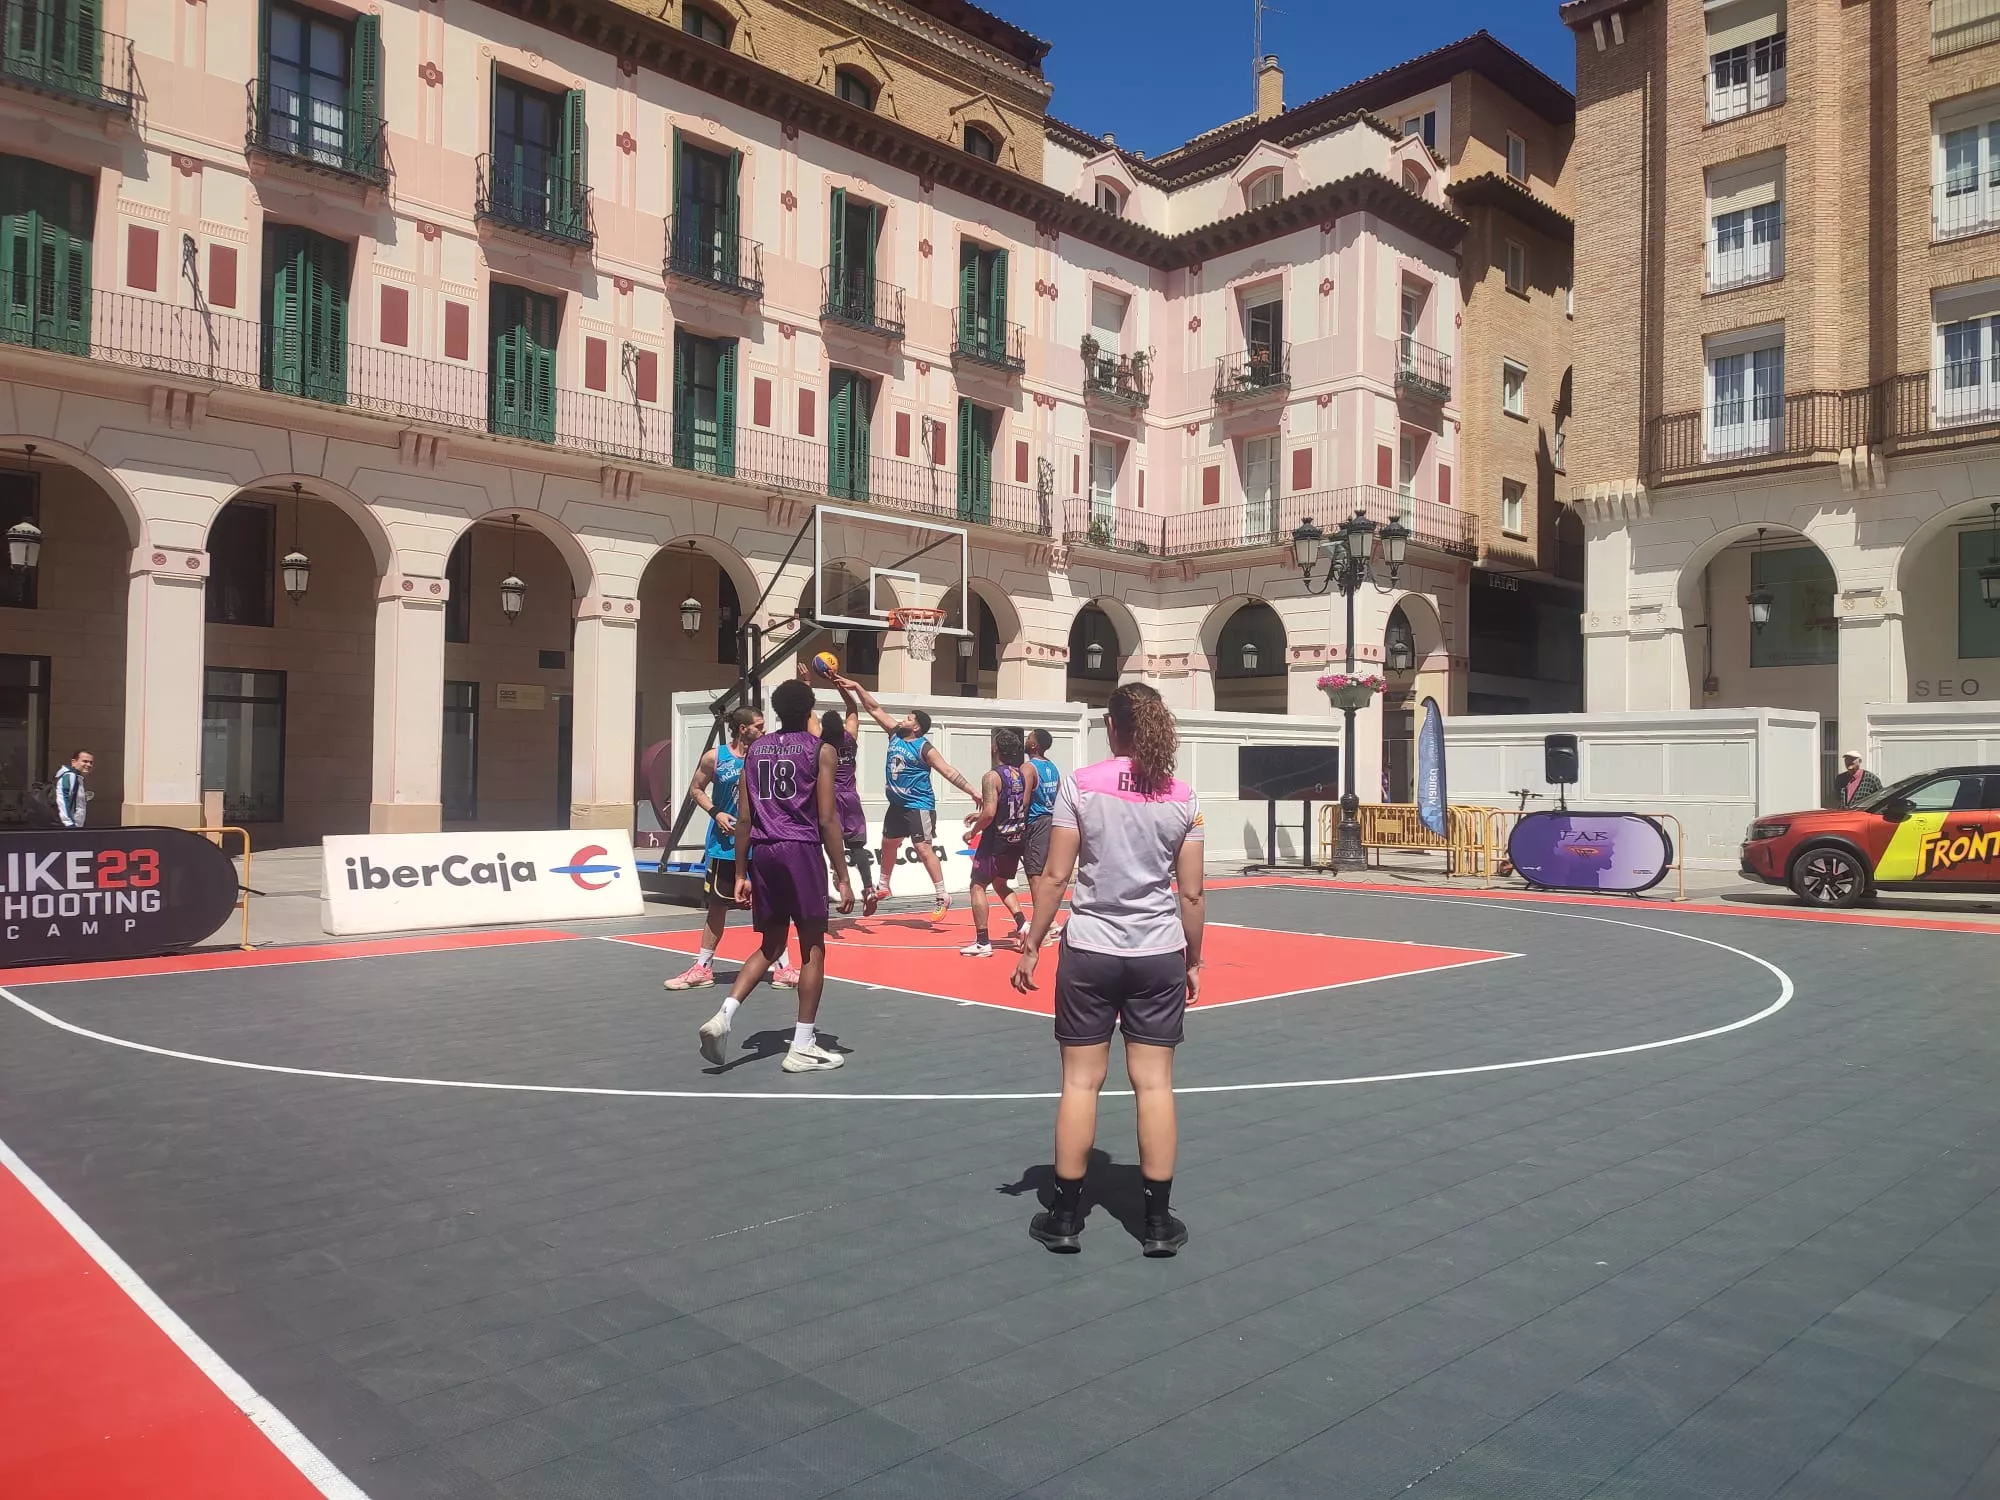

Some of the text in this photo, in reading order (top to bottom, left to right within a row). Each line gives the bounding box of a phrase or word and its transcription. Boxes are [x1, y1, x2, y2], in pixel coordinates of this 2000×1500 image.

[1915, 679, 1980, 697] SEO
[758, 759, 797, 801] 18
[0, 848, 160, 893] IKE23
[345, 852, 537, 892] iberCaja
